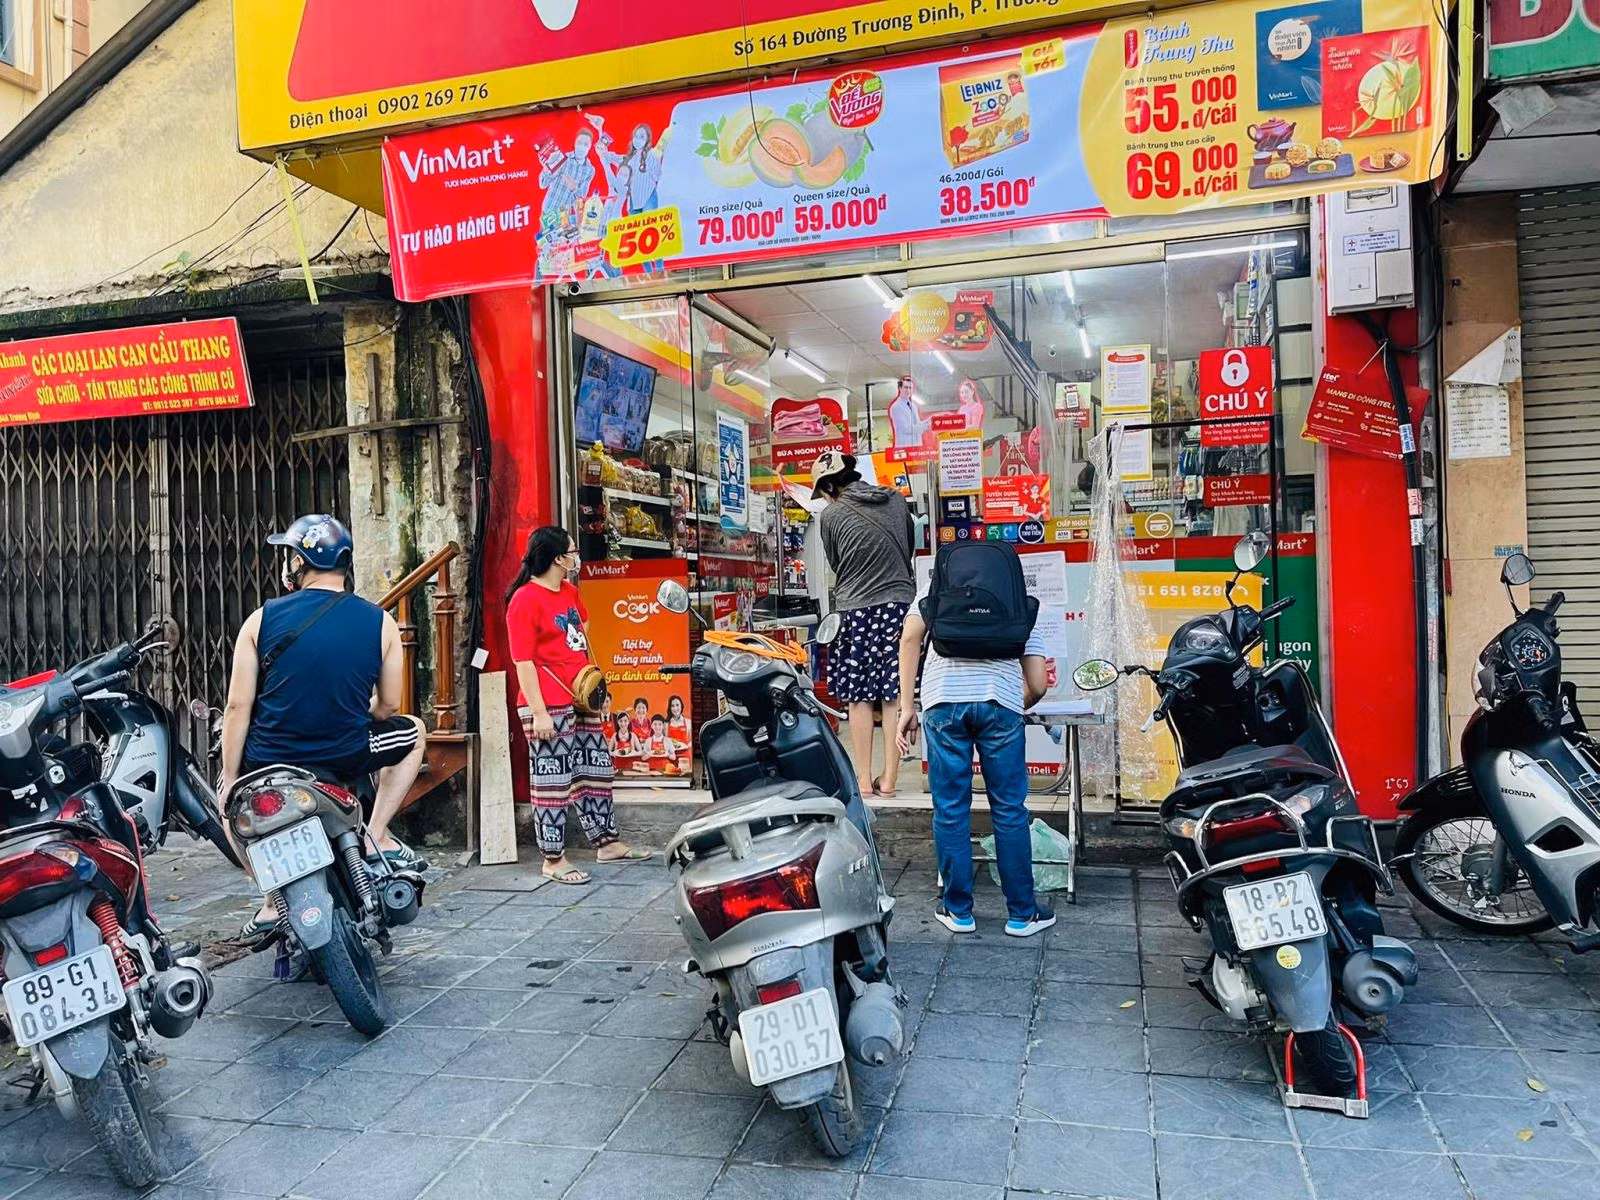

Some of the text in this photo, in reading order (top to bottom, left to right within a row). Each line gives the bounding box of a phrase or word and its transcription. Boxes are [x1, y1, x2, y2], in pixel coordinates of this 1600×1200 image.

[734, 39, 754, 57] Số
[760, 33, 787, 51] 164
[792, 25, 848, 47] Đường
[852, 13, 913, 37] Trương
[917, 2, 965, 26] Định,
[1145, 21, 1190, 43] Bánh
[1144, 45, 1197, 64] Trung
[1201, 35, 1234, 56] Thu
[1169, 71, 1183, 80] thu
[960, 78, 1003, 102] LEIBNIZ
[1192, 74, 1237, 105] 000
[290, 82, 489, 129] Điện thoại 0902 269 776
[1193, 103, 1237, 129] đ/cái
[1148, 141, 1168, 150] trung
[1170, 139, 1184, 147] thu
[1186, 138, 1200, 146] cao
[1192, 143, 1238, 173] 000
[939, 166, 1004, 184] 46.200đ/Gói
[1194, 172, 1238, 197] đ/cái
[793, 191, 824, 204] Queen
[940, 176, 1036, 216] 38.500đ
[699, 205, 720, 216] King
[401, 203, 531, 256] TỰ HÀO HÀNG VIỆT
[617, 223, 676, 260] 50%
[31, 330, 231, 377] CÁC LOẠI LAN CAN CẦU THANG
[36, 380, 56, 406] SỬA
[57, 380, 81, 405] CHỮA
[107, 378, 138, 399] TRANG
[139, 374, 159, 396] CÁC
[160, 372, 188, 394] CÔNG
[189, 370, 219, 392] TRÌNH
[221, 366, 236, 390] CŨ
[1205, 386, 1268, 412] CHÚ Ý
[794, 447, 817, 456] NGON
[1210, 478, 1240, 489] CHÚ Ý
[1161, 585, 1187, 597] 159
[1193, 585, 1226, 597] 828
[605, 671, 622, 683] Gia
[1027, 766, 1051, 774] TDeli
[1500, 787, 1536, 799] HONDA
[22, 956, 98, 1005] 89-G1
[20, 980, 119, 1040] 084.34
[754, 1028, 831, 1078] 030.57
